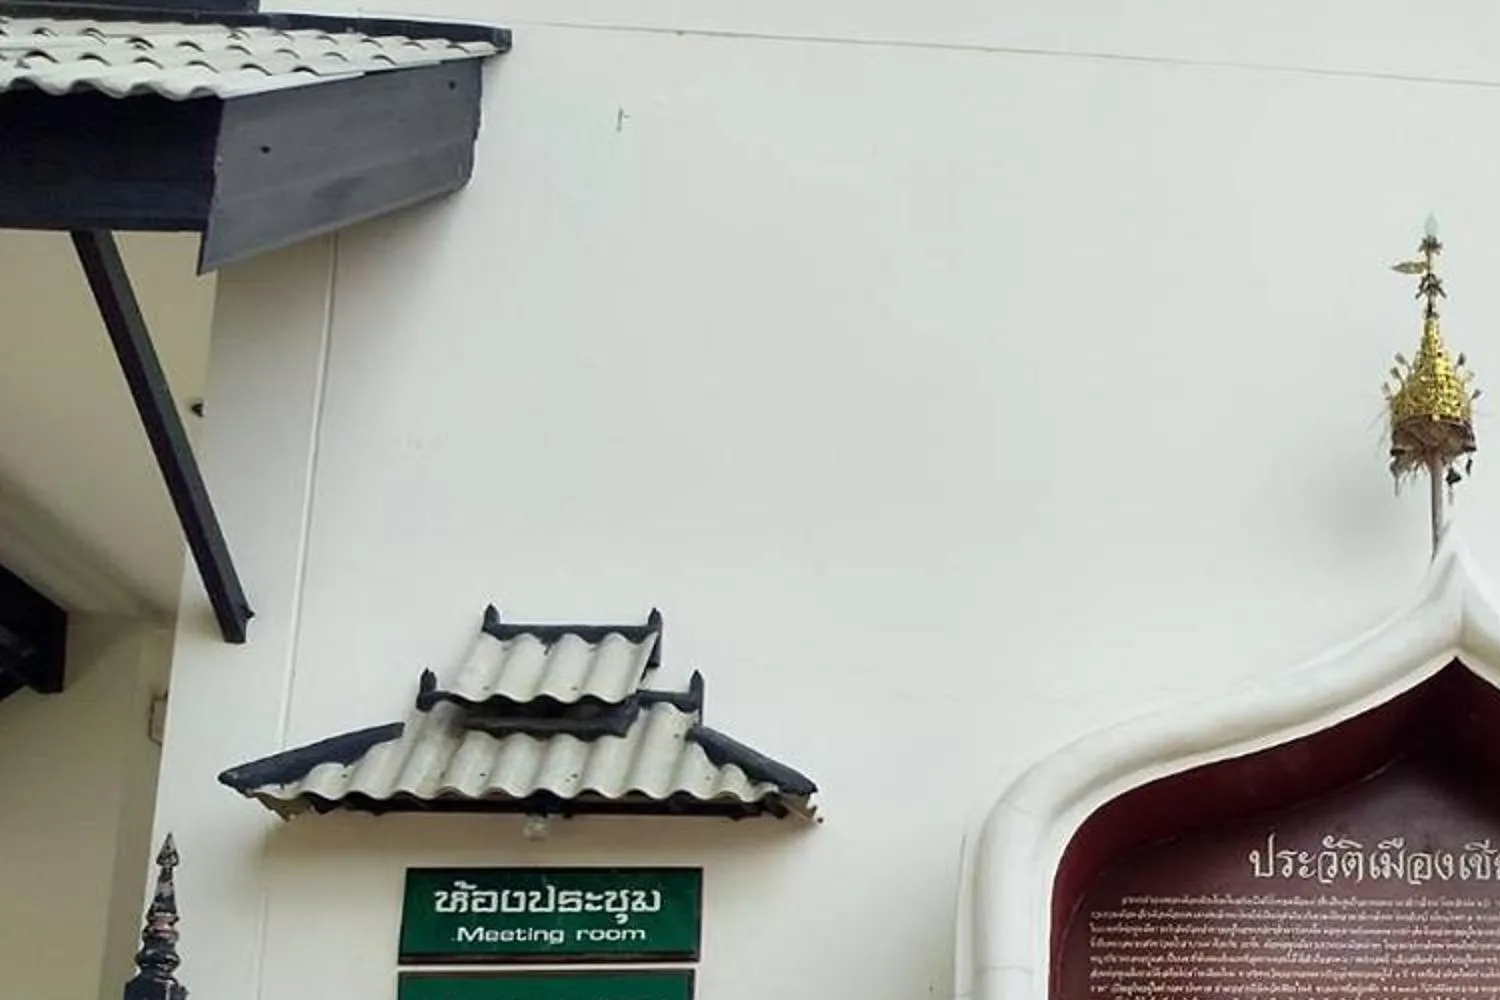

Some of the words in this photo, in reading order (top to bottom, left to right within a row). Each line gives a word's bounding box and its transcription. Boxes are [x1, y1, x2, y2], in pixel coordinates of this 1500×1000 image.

[434, 880, 661, 925] ห้องประชุม
[457, 927, 564, 944] Meeting
[576, 928, 646, 941] room
